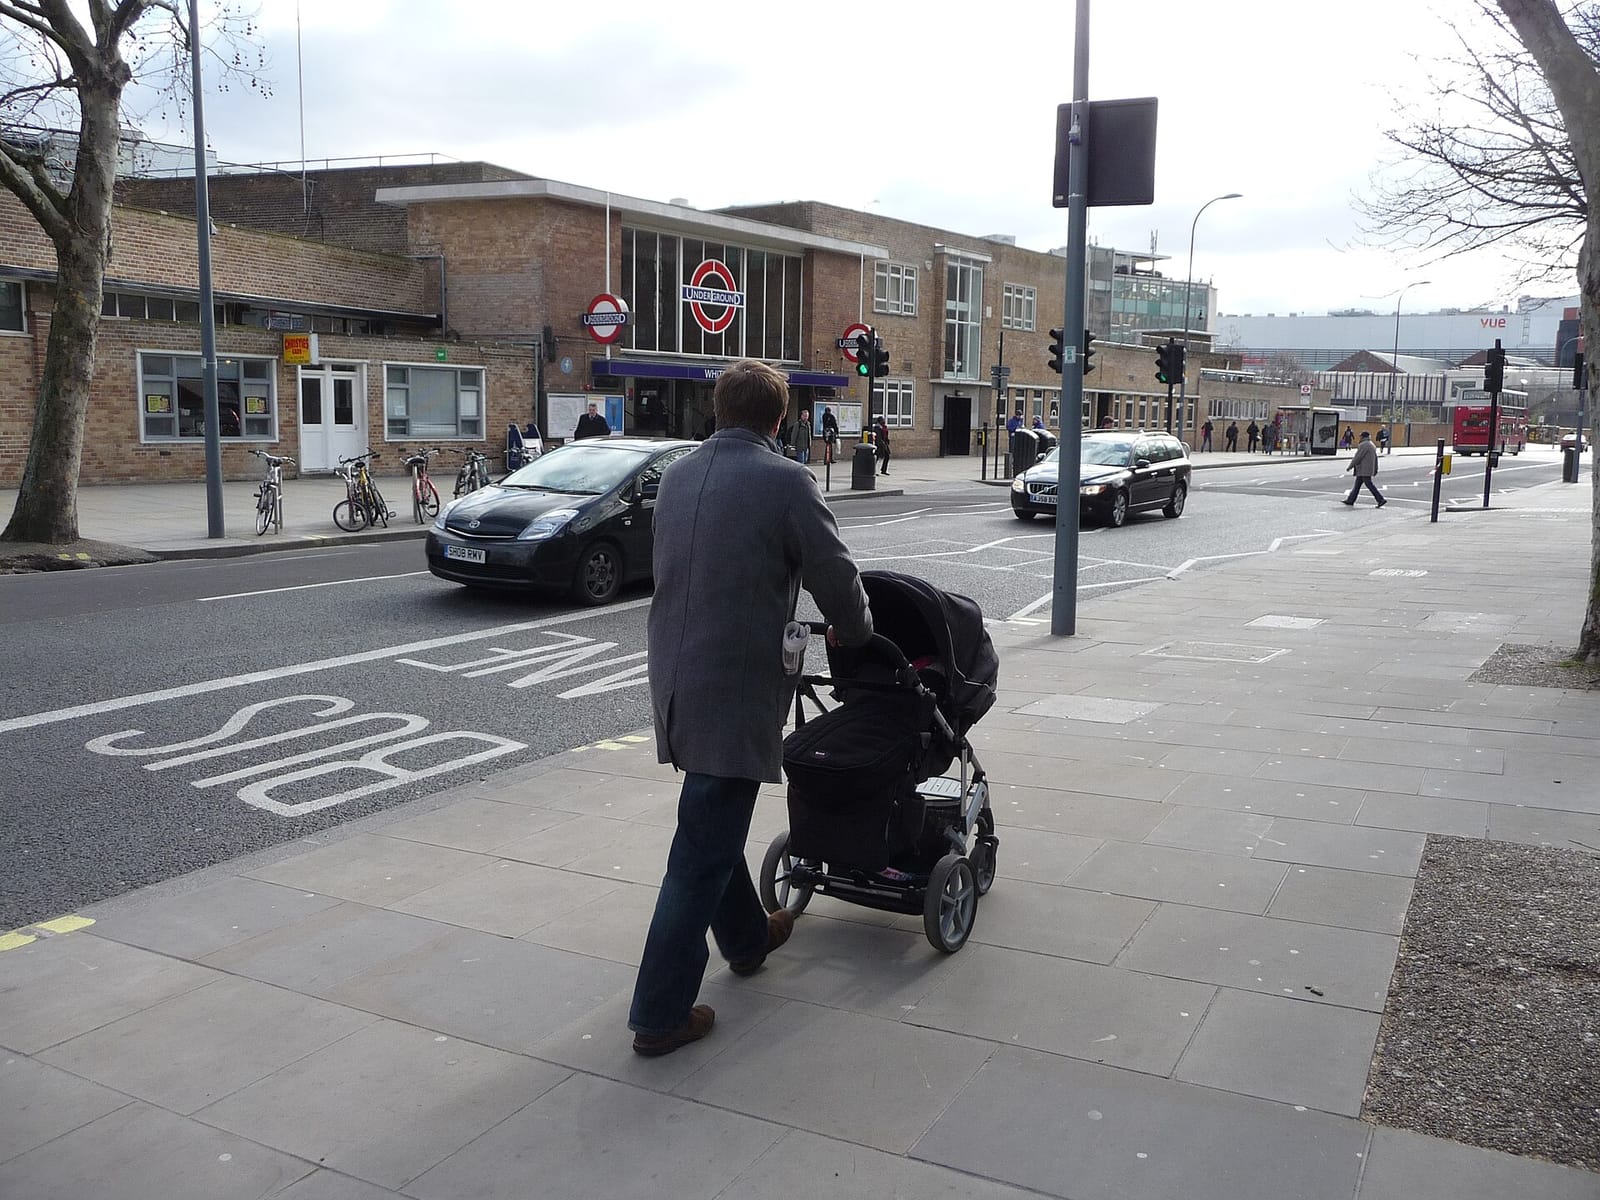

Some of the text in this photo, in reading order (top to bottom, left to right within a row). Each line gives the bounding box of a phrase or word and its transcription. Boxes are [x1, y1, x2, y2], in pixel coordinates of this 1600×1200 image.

[686, 287, 741, 305] UNDERGROUND
[583, 313, 626, 325] UNDERGROUND
[1480, 318, 1506, 329] vue
[704, 369, 724, 380] WHIT
[467, 549, 483, 561] RMV
[85, 694, 528, 818] BUS
